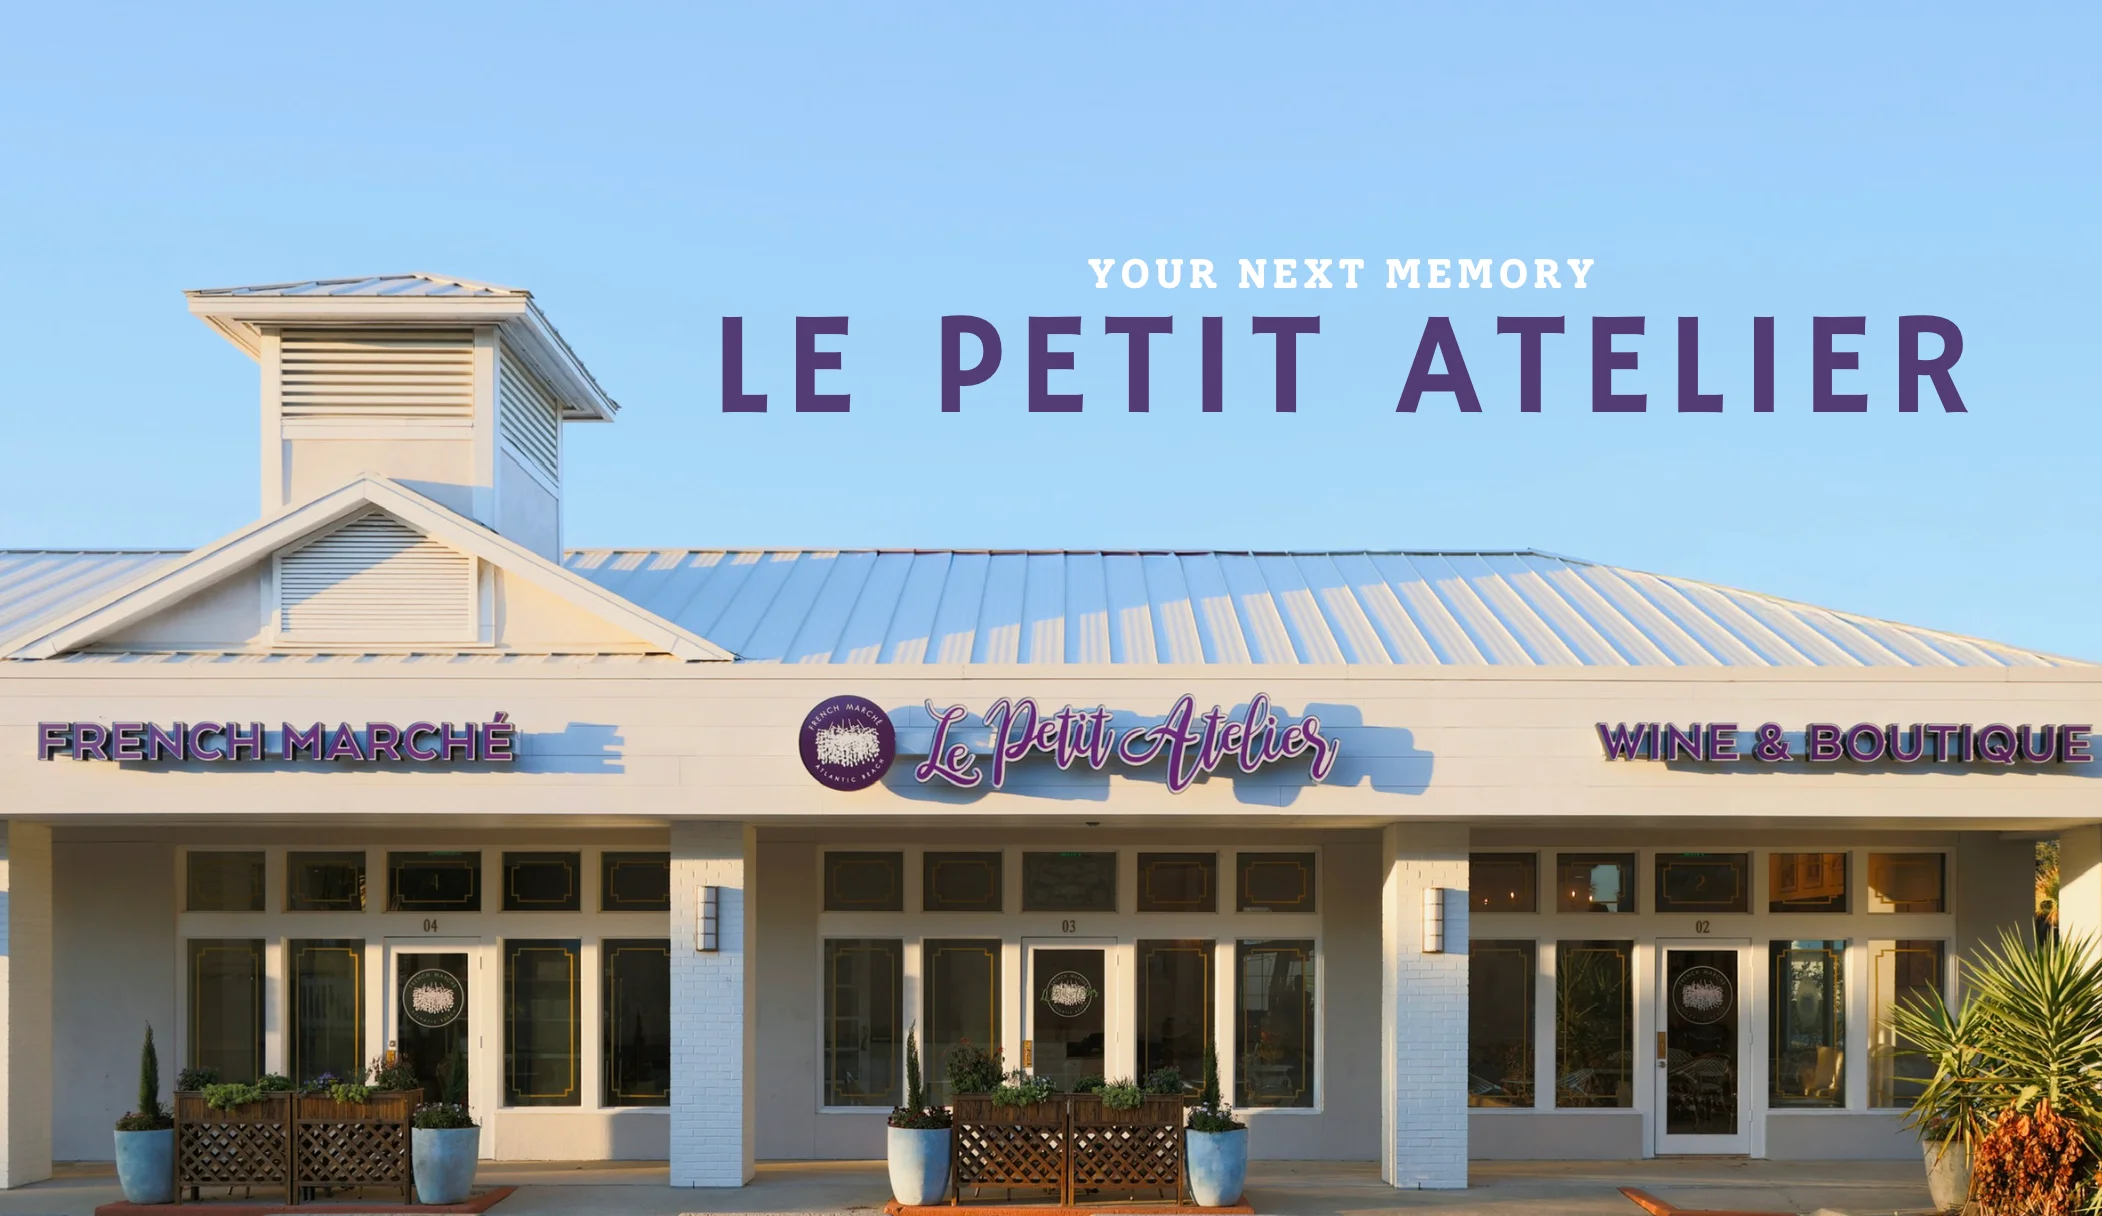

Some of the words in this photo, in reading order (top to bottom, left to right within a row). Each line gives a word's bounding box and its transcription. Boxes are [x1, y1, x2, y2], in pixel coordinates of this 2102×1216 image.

[808, 704, 840, 731] FRENCH
[845, 703, 883, 726] MARCHÉ
[37, 721, 266, 762] FRENCH
[281, 711, 515, 762] MARCHÉ
[914, 698, 984, 789] Le
[983, 696, 1114, 791] Petit
[1118, 692, 1339, 794] Atelier
[1595, 722, 1740, 762] WINE
[1754, 722, 1793, 762] &
[1805, 722, 2094, 764] BOUTIQUE
[814, 764, 856, 783] ATLANTIC
[861, 758, 885, 780] BEACH
[423, 918, 438, 932] 04
[1062, 919, 1076, 933] 03
[1695, 920, 1710, 934] 02
